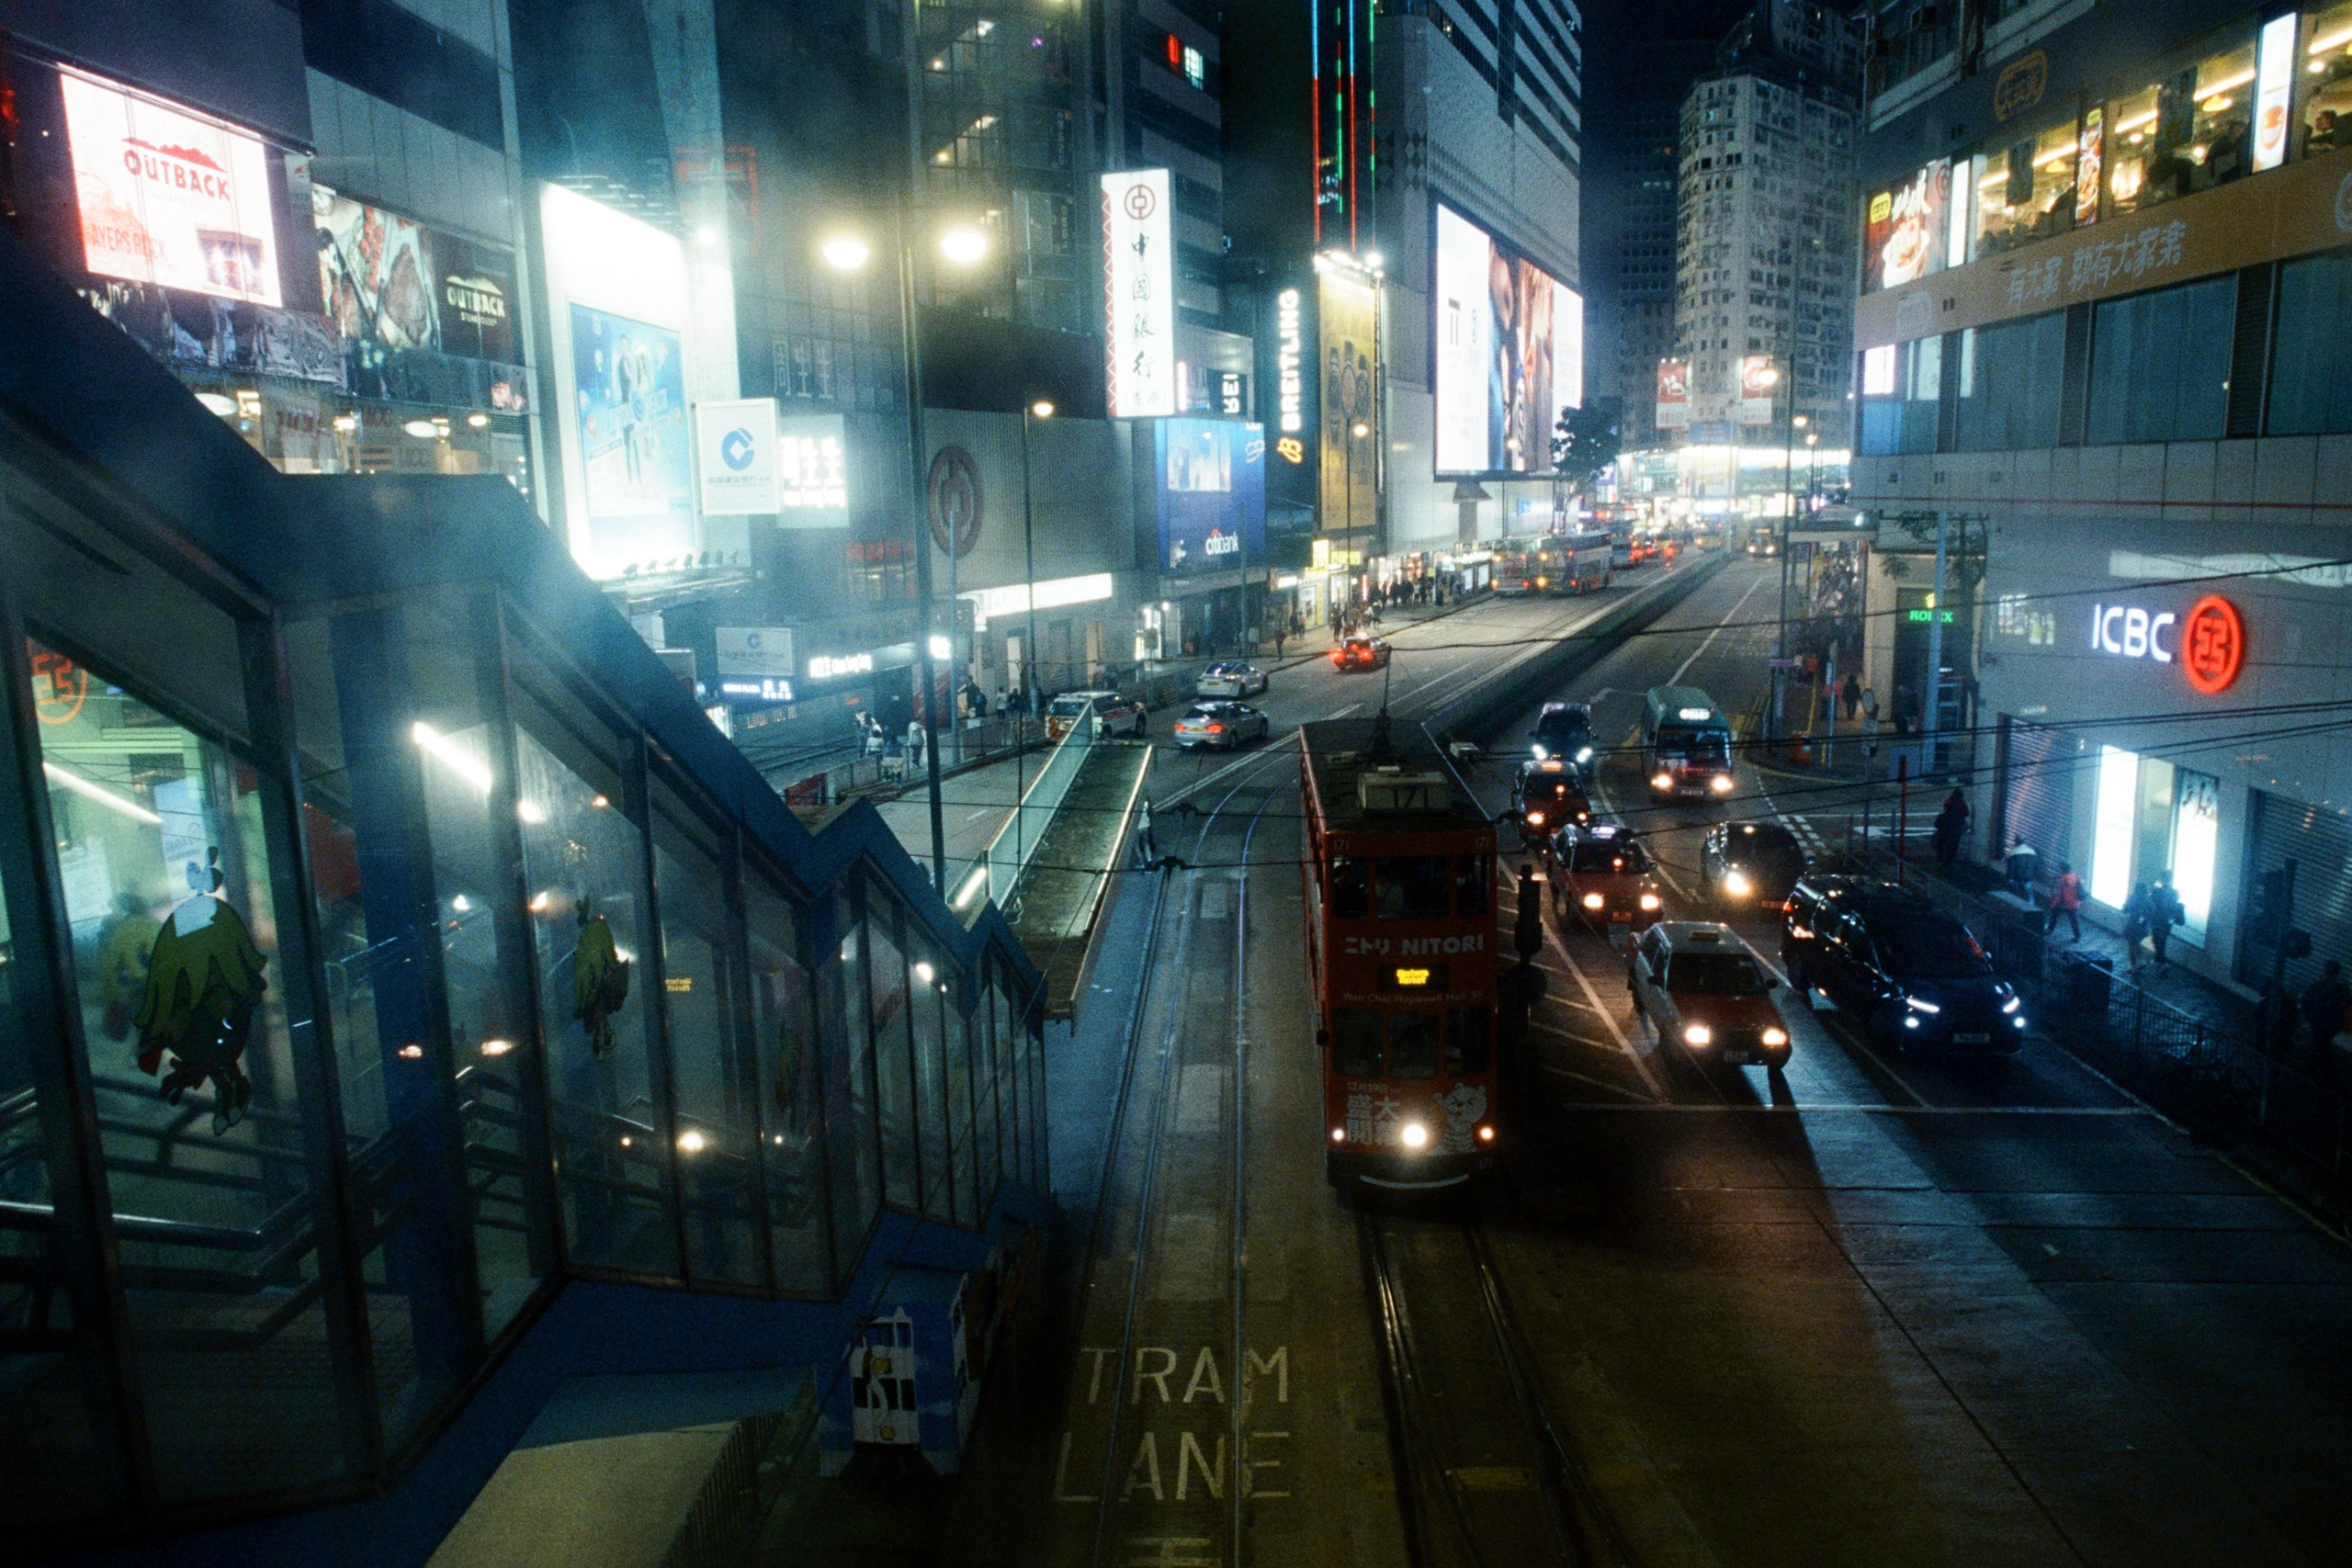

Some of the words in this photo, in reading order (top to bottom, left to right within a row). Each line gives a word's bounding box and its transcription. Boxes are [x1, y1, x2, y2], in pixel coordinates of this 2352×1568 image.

[124, 149, 231, 201] OUTBACK
[447, 286, 505, 318] OUTBACK
[1131, 232, 1154, 378] 中國銀行
[1278, 289, 1301, 431] BREITLING
[1205, 530, 1239, 555] citibank
[2093, 604, 2175, 662] ICBC
[1345, 936, 1390, 955] ニトリ
[1401, 934, 1484, 955] NITORI
[1342, 992, 1364, 1002] Wan
[1079, 1346, 1288, 1405] TRAM
[1053, 1431, 1291, 1503] LANE
